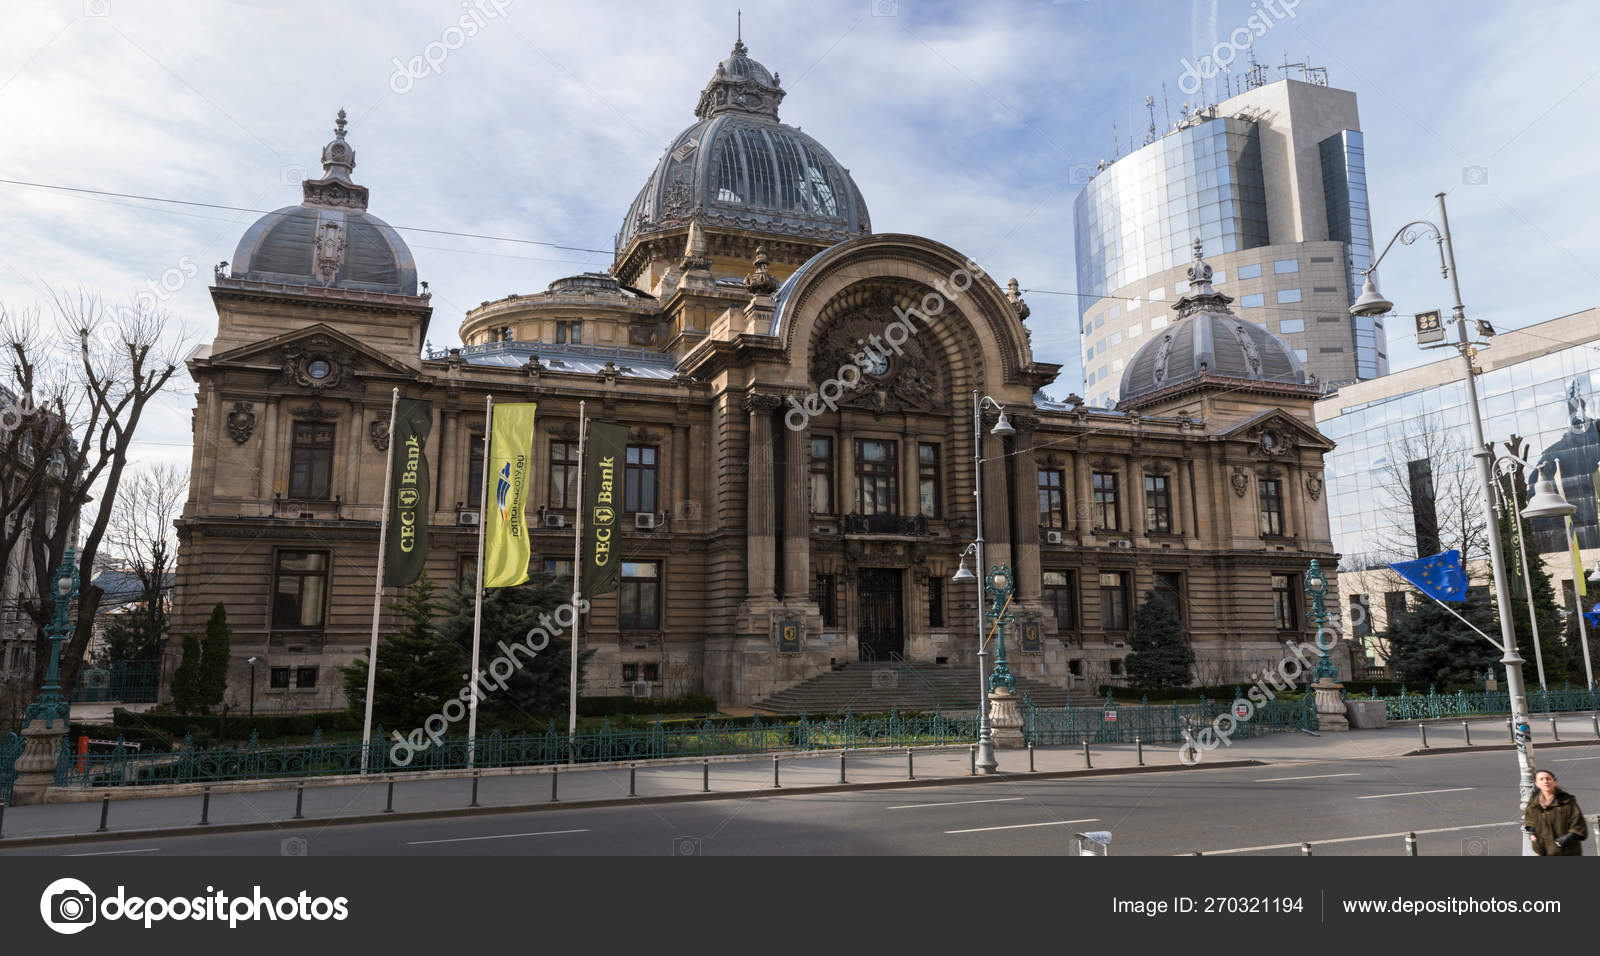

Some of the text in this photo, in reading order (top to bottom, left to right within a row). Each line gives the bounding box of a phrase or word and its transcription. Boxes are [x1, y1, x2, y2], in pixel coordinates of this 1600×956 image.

[401, 434, 420, 553] CEC Bank
[595, 456, 614, 567] CEC Bank
